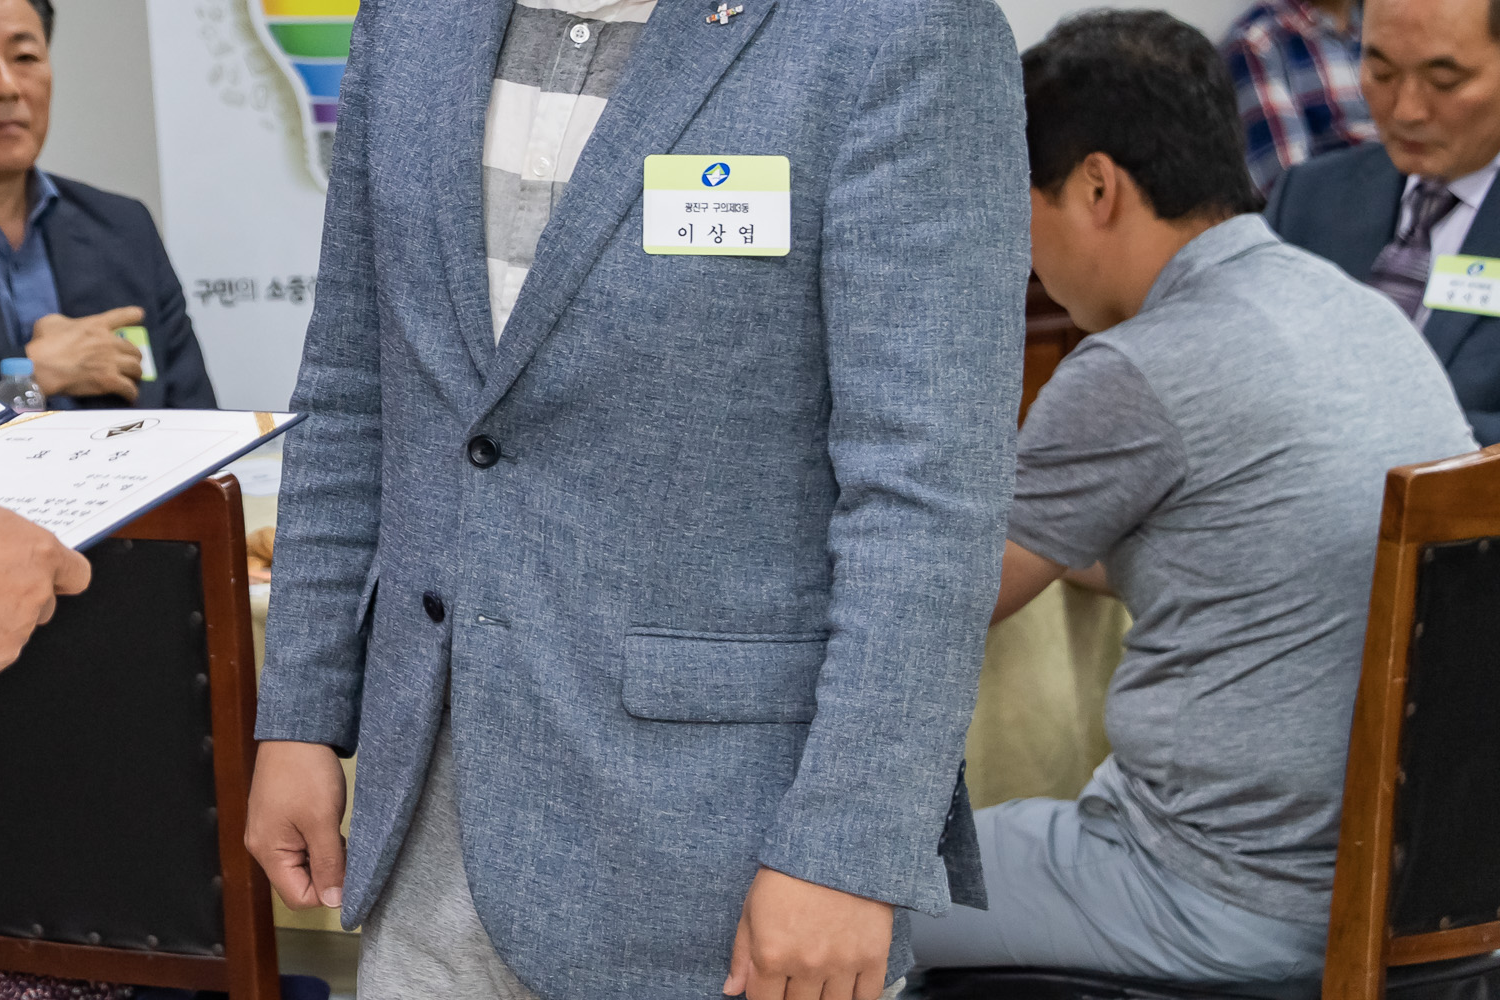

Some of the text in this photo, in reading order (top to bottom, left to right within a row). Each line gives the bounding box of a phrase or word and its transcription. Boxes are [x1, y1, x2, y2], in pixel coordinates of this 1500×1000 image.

[685, 202, 749, 213] 광진구 구의제3동
[264, 274, 317, 305] 소중
